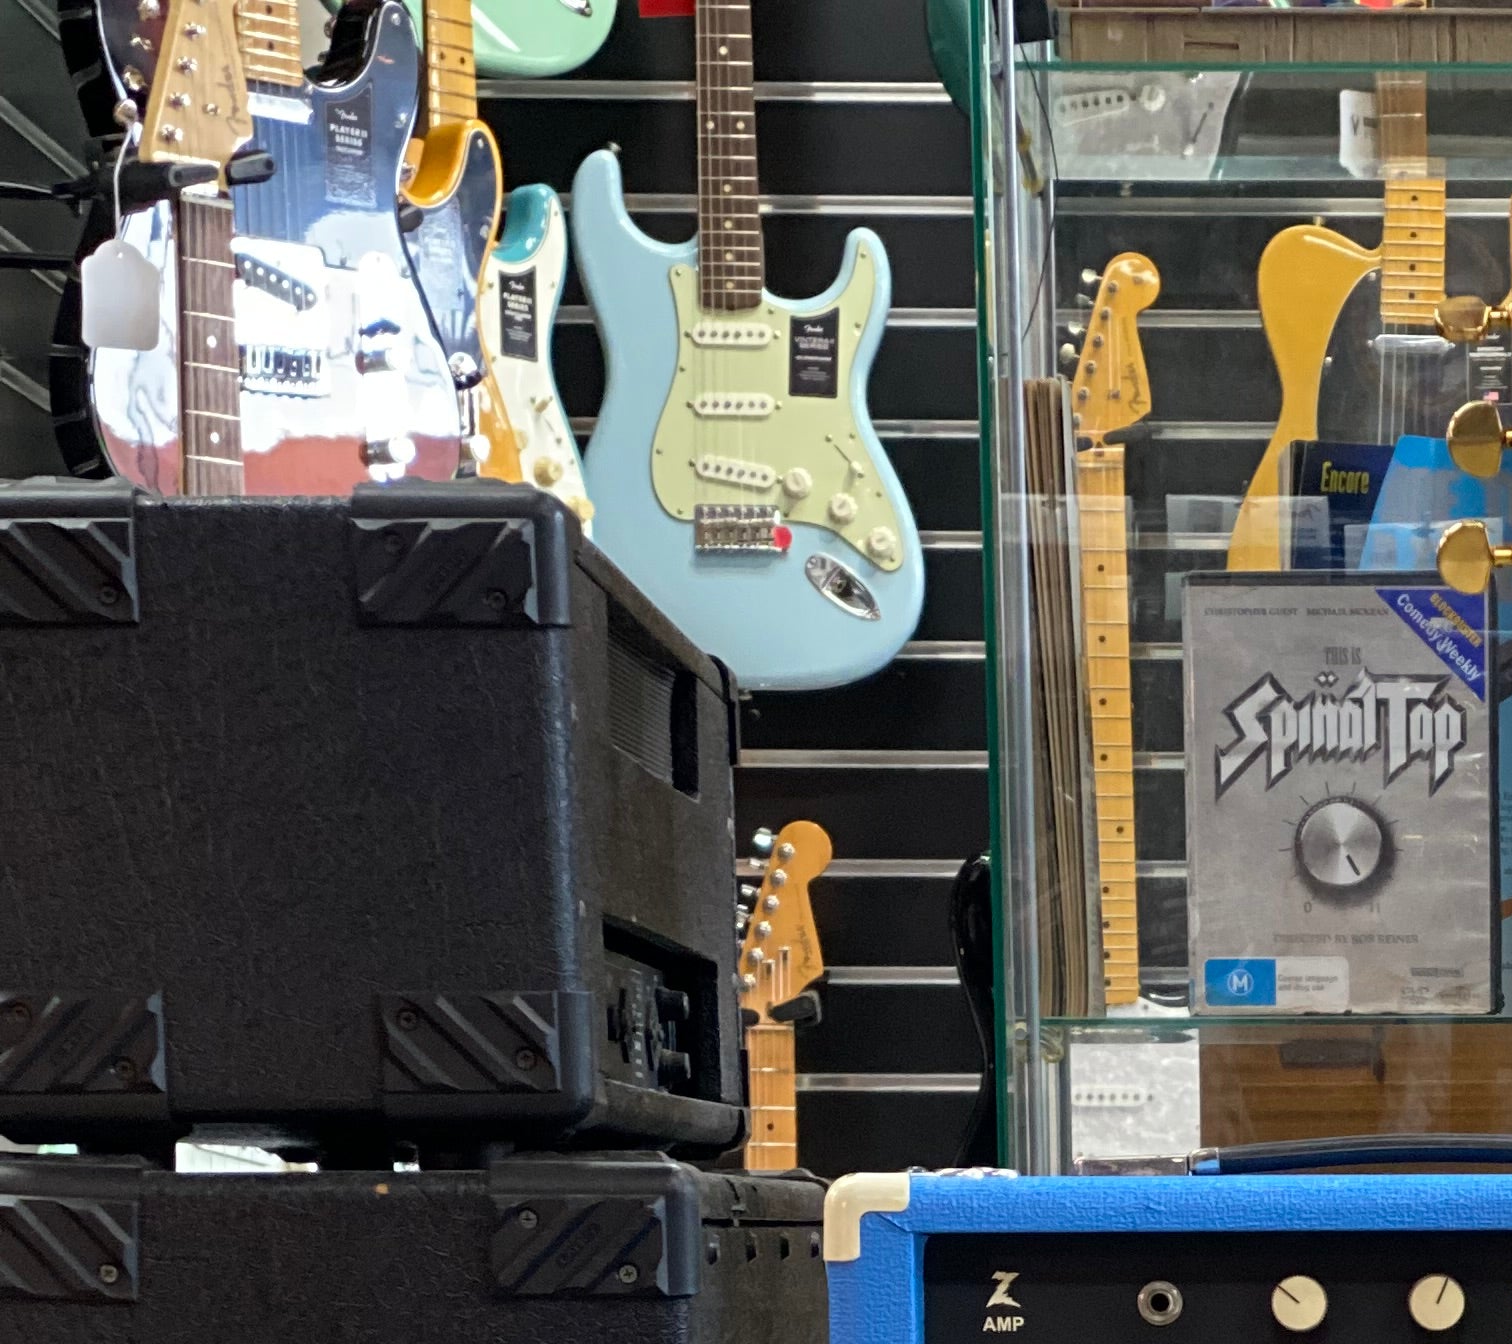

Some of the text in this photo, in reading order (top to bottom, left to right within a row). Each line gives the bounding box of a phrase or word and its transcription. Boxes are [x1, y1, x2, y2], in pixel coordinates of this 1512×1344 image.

[1320, 461, 1370, 494] Encore
[1324, 647, 1361, 665] THIS IS
[1375, 674, 1468, 797] Tap
[983, 1316, 1025, 1332] AMP
